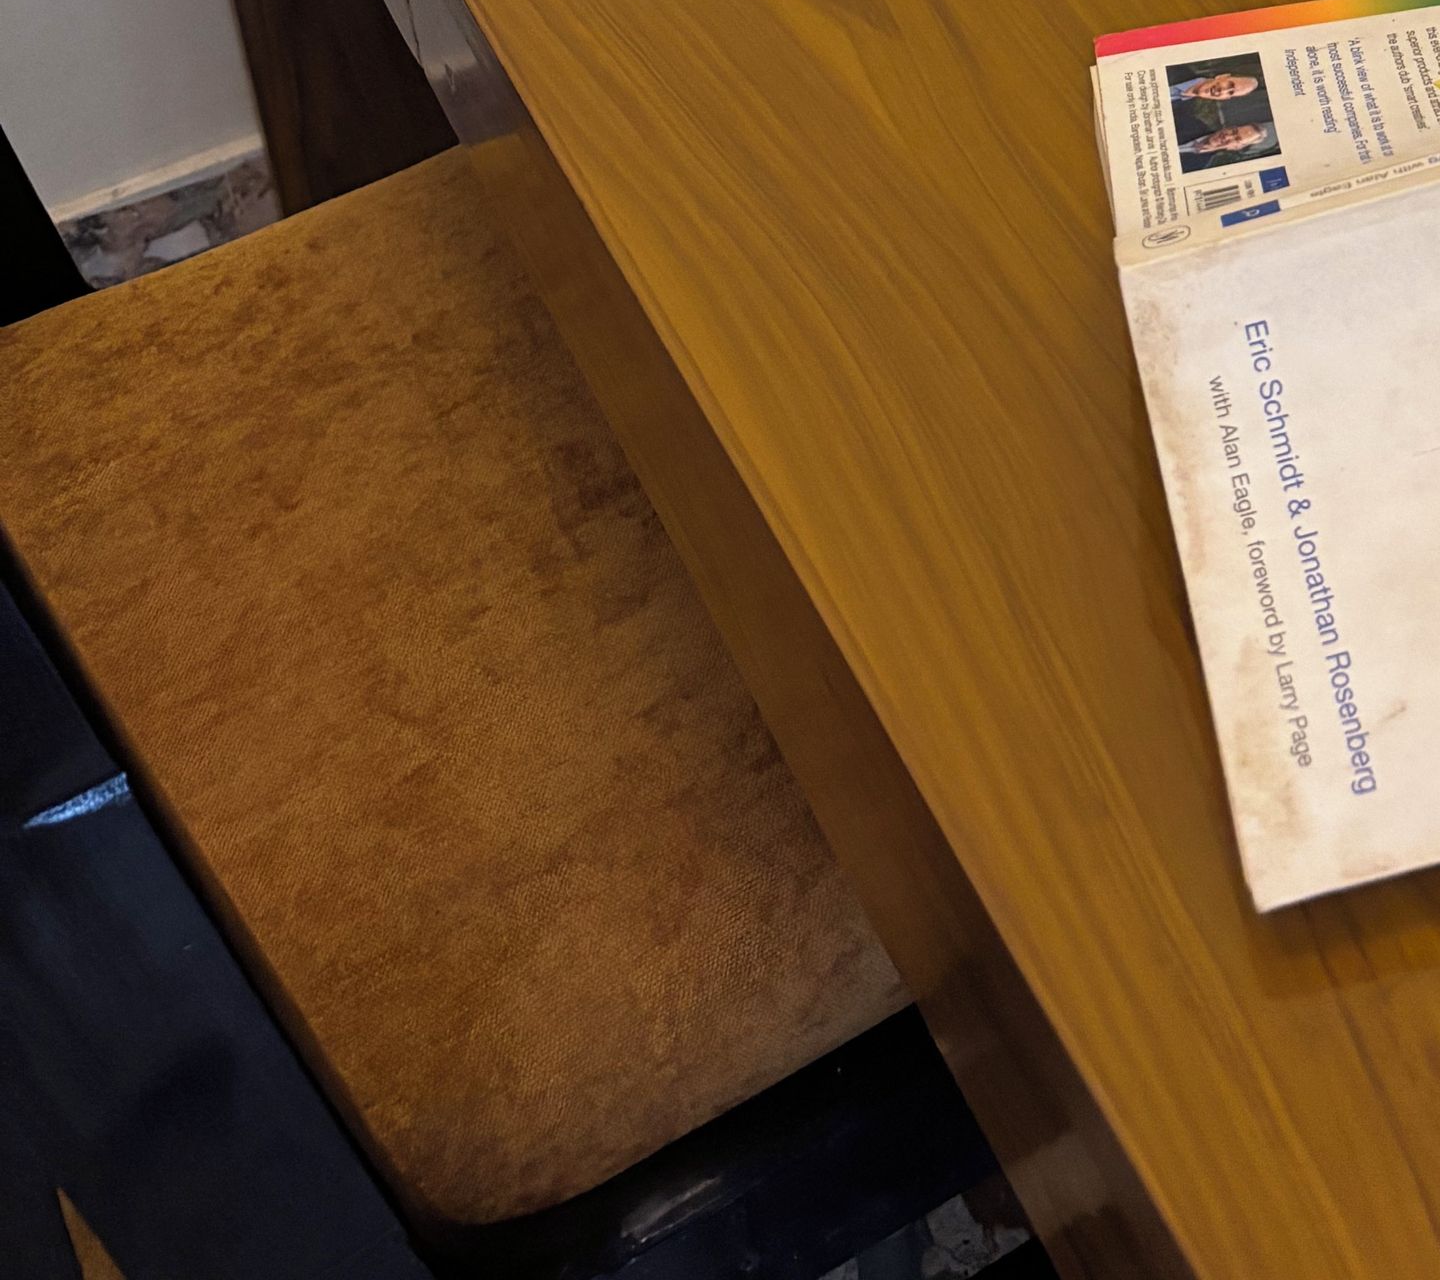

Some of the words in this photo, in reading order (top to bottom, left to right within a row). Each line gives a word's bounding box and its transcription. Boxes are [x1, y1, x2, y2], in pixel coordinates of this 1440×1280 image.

[1284, 48, 1306, 96] Independent
[1321, 41, 1342, 62] most
[1312, 75, 1326, 84] is
[1315, 83, 1332, 106] worth
[1331, 62, 1354, 101] successful
[1243, 319, 1273, 373] Eric
[1208, 375, 1232, 419] with
[1218, 425, 1241, 469] Alan
[1258, 379, 1304, 492] Schmidt
[1230, 472, 1257, 536] Eagle,
[1286, 498, 1311, 520] &
[1245, 540, 1283, 628] foreword
[1293, 525, 1338, 646] Jonathan
[1264, 631, 1286, 657] by
[1274, 660, 1299, 711] Larry
[1287, 715, 1311, 767] Page
[1324, 650, 1376, 795] Rosenberg
